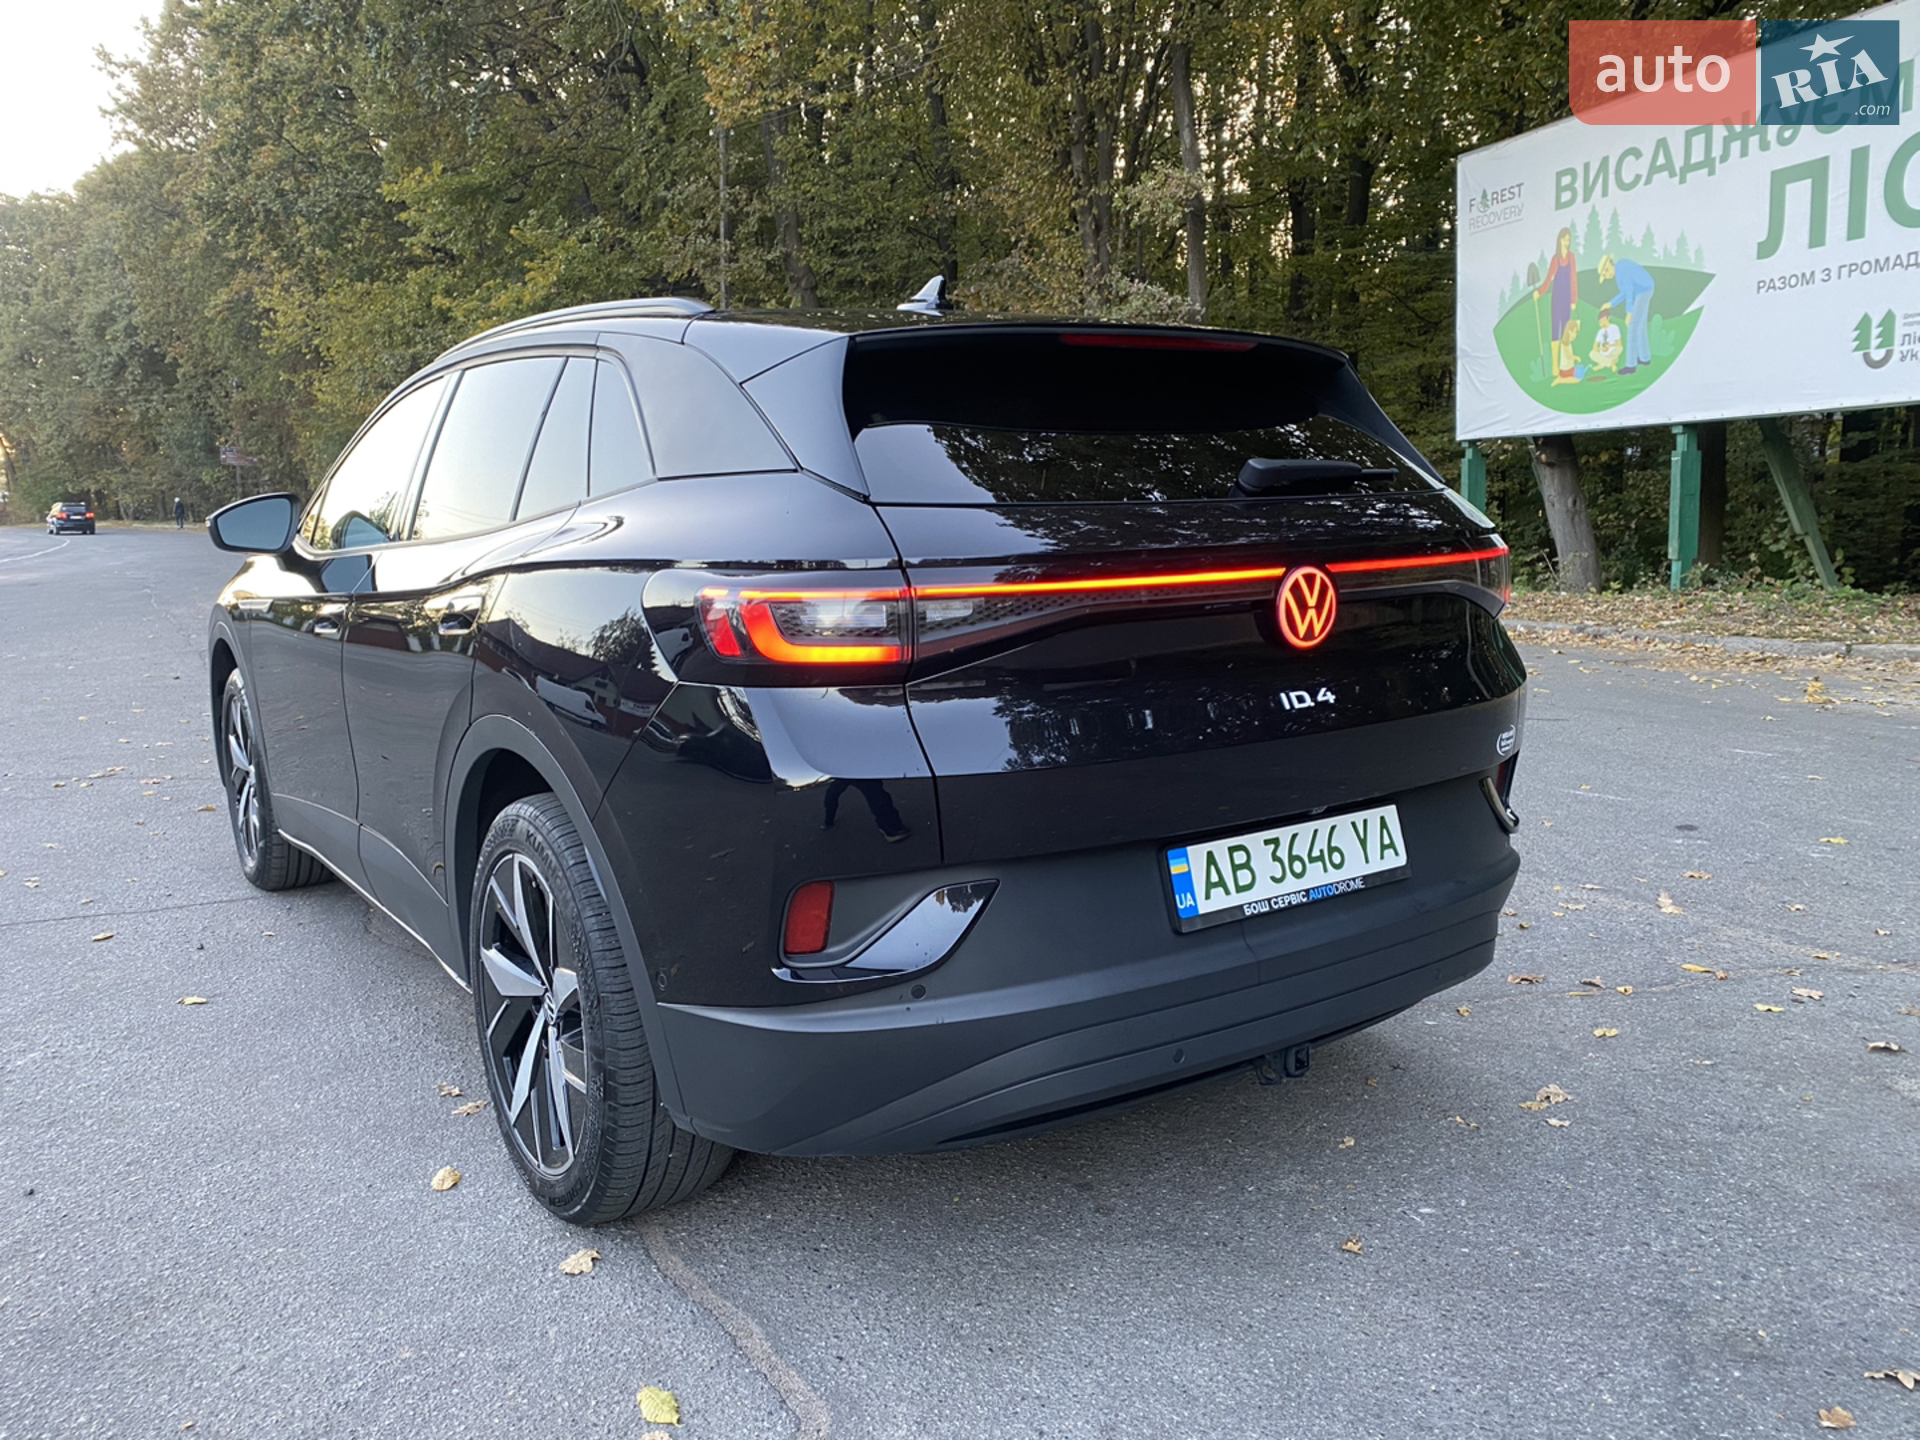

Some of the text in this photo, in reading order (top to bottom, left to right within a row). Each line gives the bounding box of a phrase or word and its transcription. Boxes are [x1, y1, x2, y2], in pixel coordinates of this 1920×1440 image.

[1757, 271, 1815, 294] РАЗОМ
[1204, 815, 1400, 900] AB 3646 YA
[1176, 892, 1195, 909] UA
[1243, 877, 1366, 916] БОШ СЕРВІС AUTODROME
